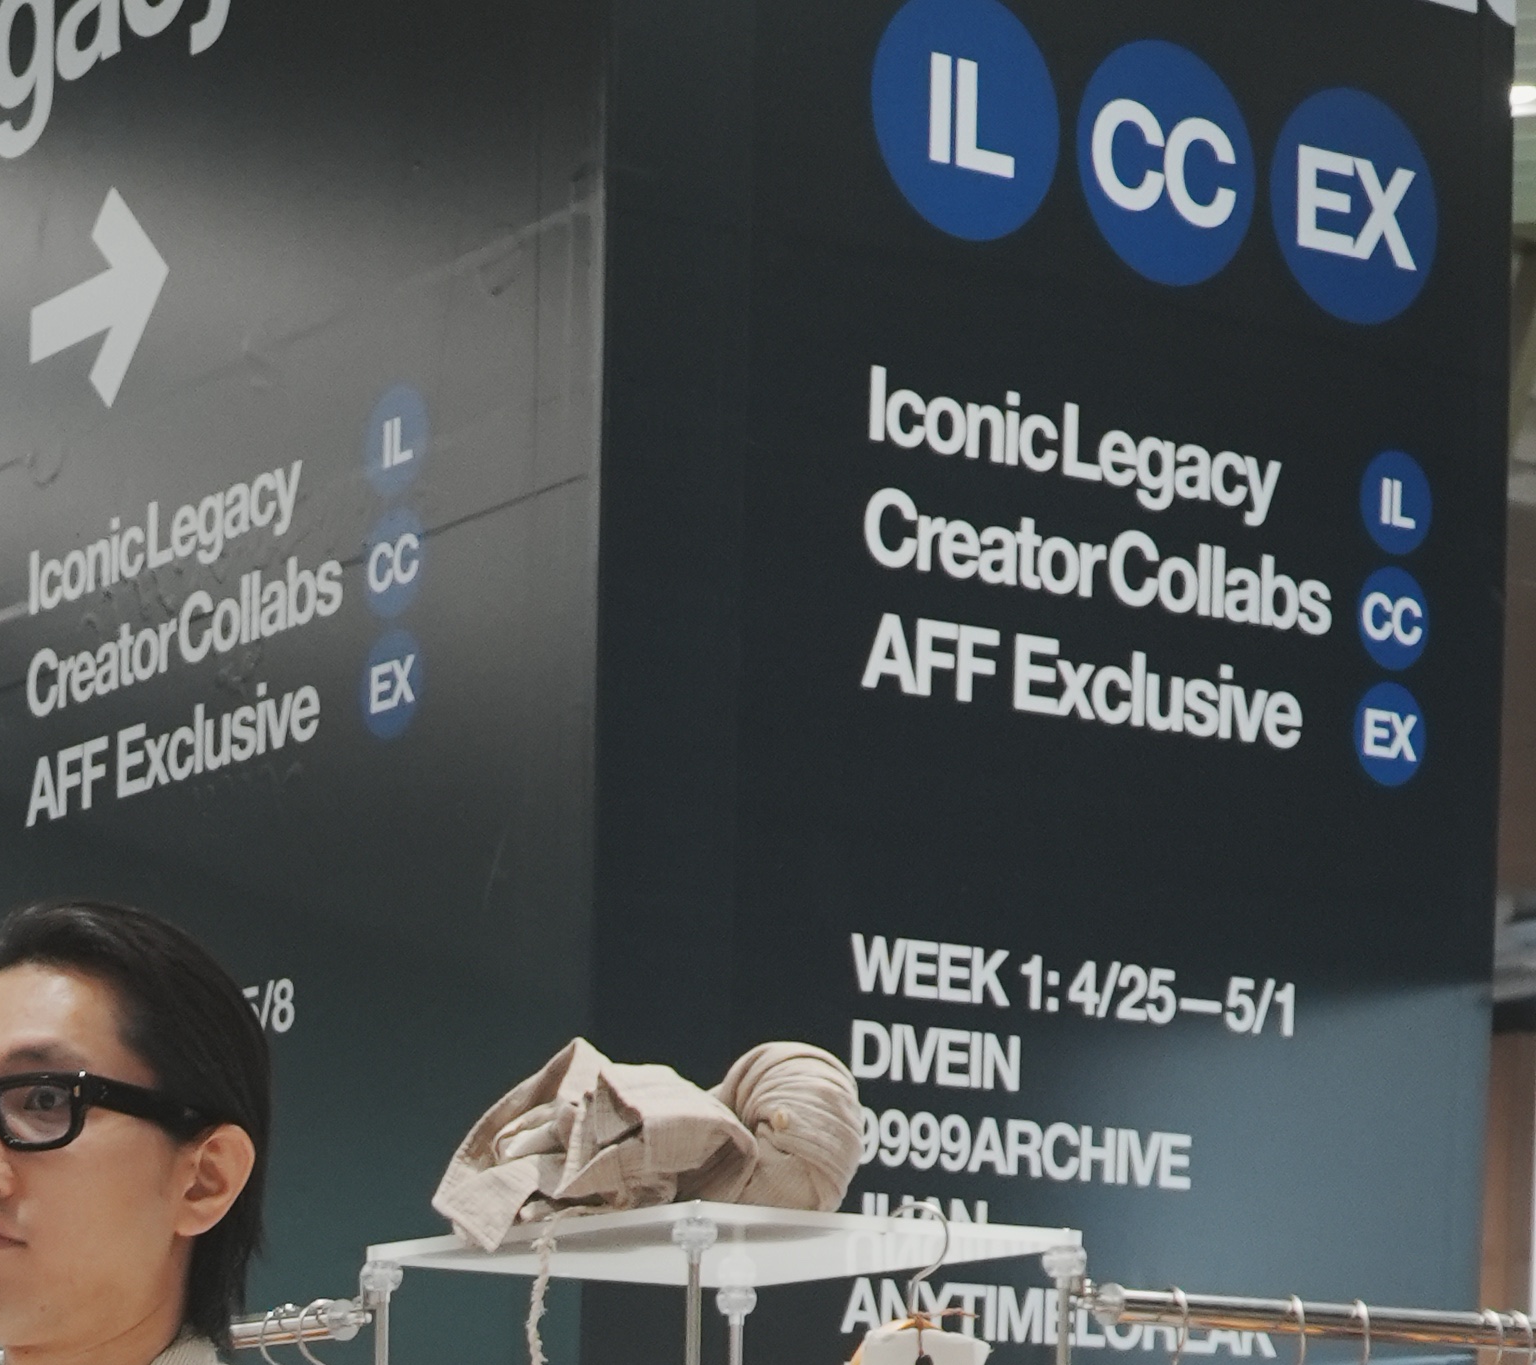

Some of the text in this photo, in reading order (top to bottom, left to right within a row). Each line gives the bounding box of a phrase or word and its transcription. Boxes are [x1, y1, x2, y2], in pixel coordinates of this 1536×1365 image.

[929, 52, 1417, 271] IL CC EX
[382, 417, 413, 468] IL
[1380, 477, 1416, 530] IL
[368, 532, 419, 594] CC
[1361, 592, 1423, 646] CC
[861, 613, 1417, 762] AFF Exclusive EX
[25, 654, 415, 826] AFF Exclusive EX
[851, 932, 1011, 1008] WEEK
[850, 1020, 1020, 1093] DIVEIN
